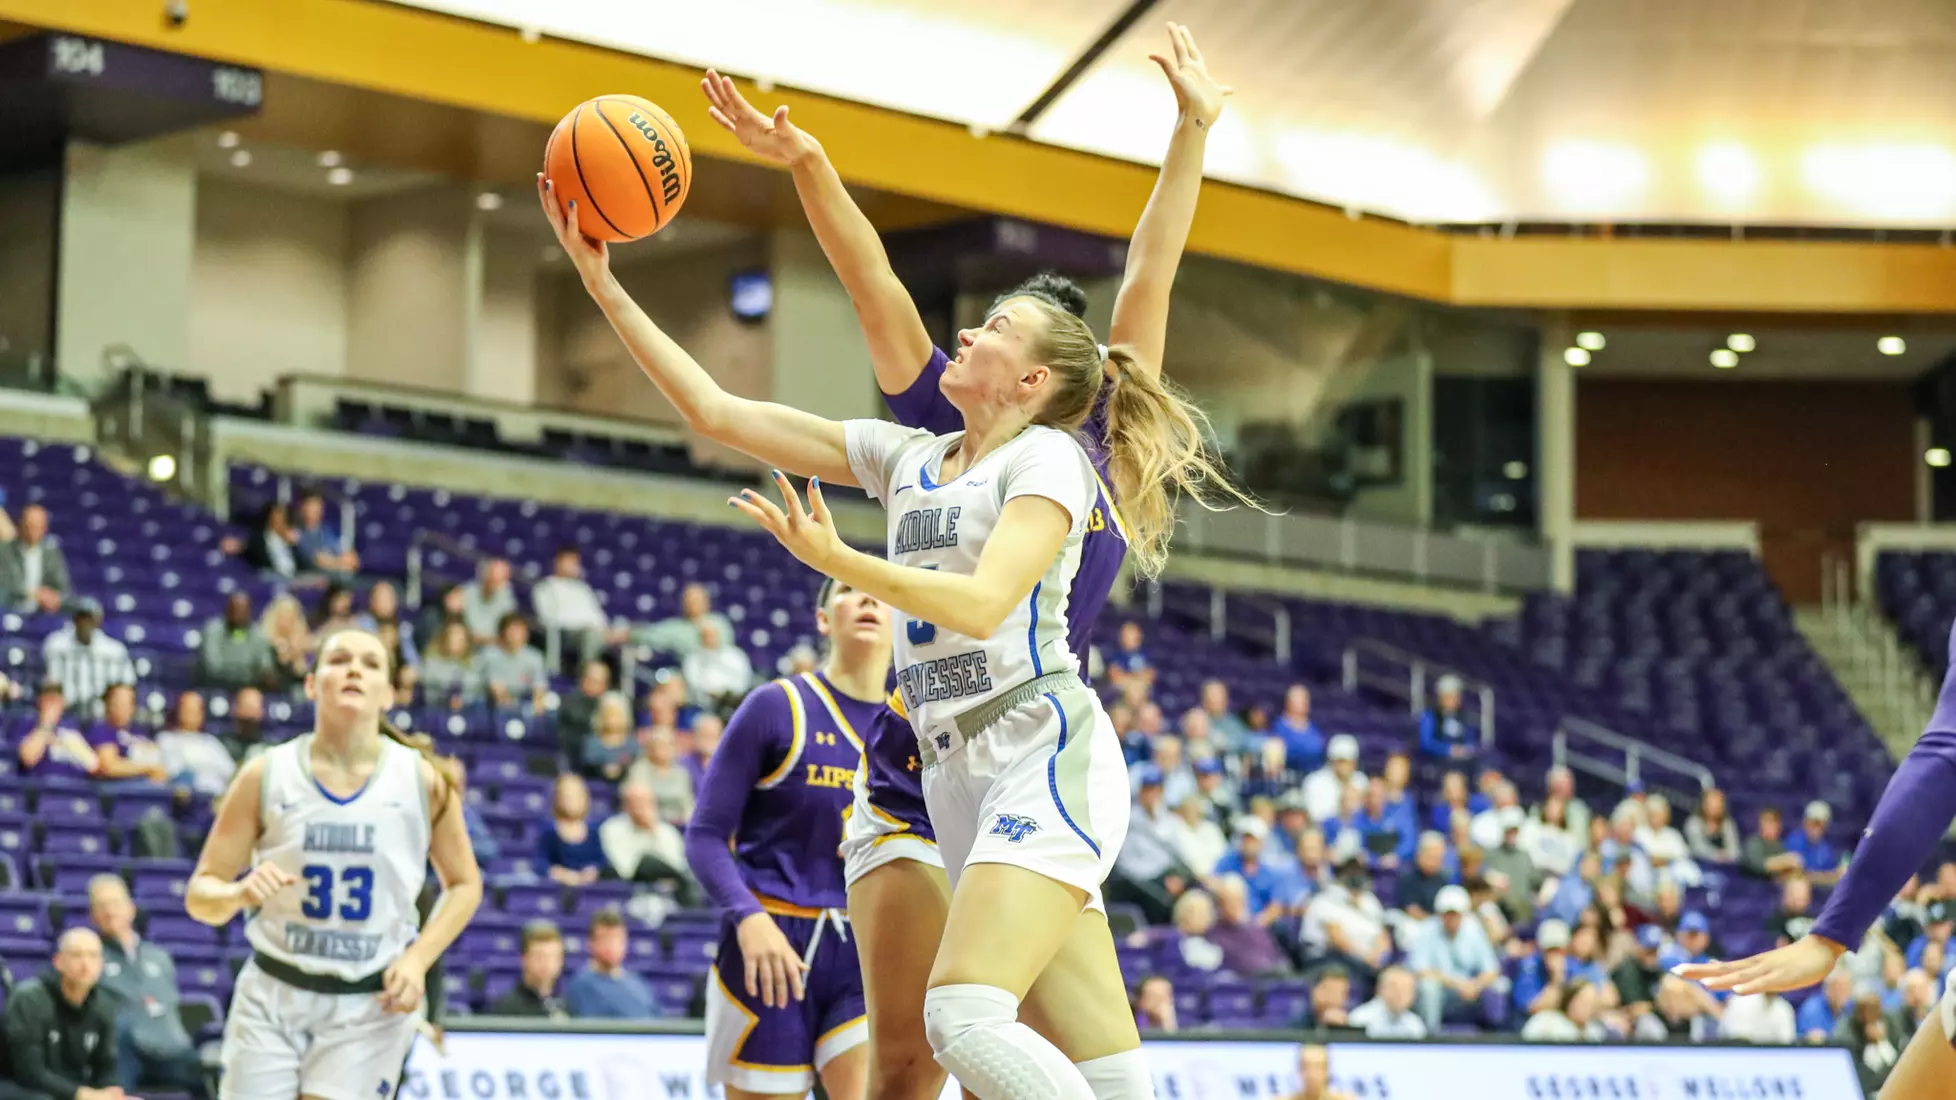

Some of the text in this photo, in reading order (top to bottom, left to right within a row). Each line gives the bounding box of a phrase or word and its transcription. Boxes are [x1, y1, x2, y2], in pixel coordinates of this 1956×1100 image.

[628, 111, 681, 206] Wilson
[895, 506, 961, 555] MIDDLE
[301, 865, 374, 921] 33
[404, 1070, 591, 1100] GEORGE
